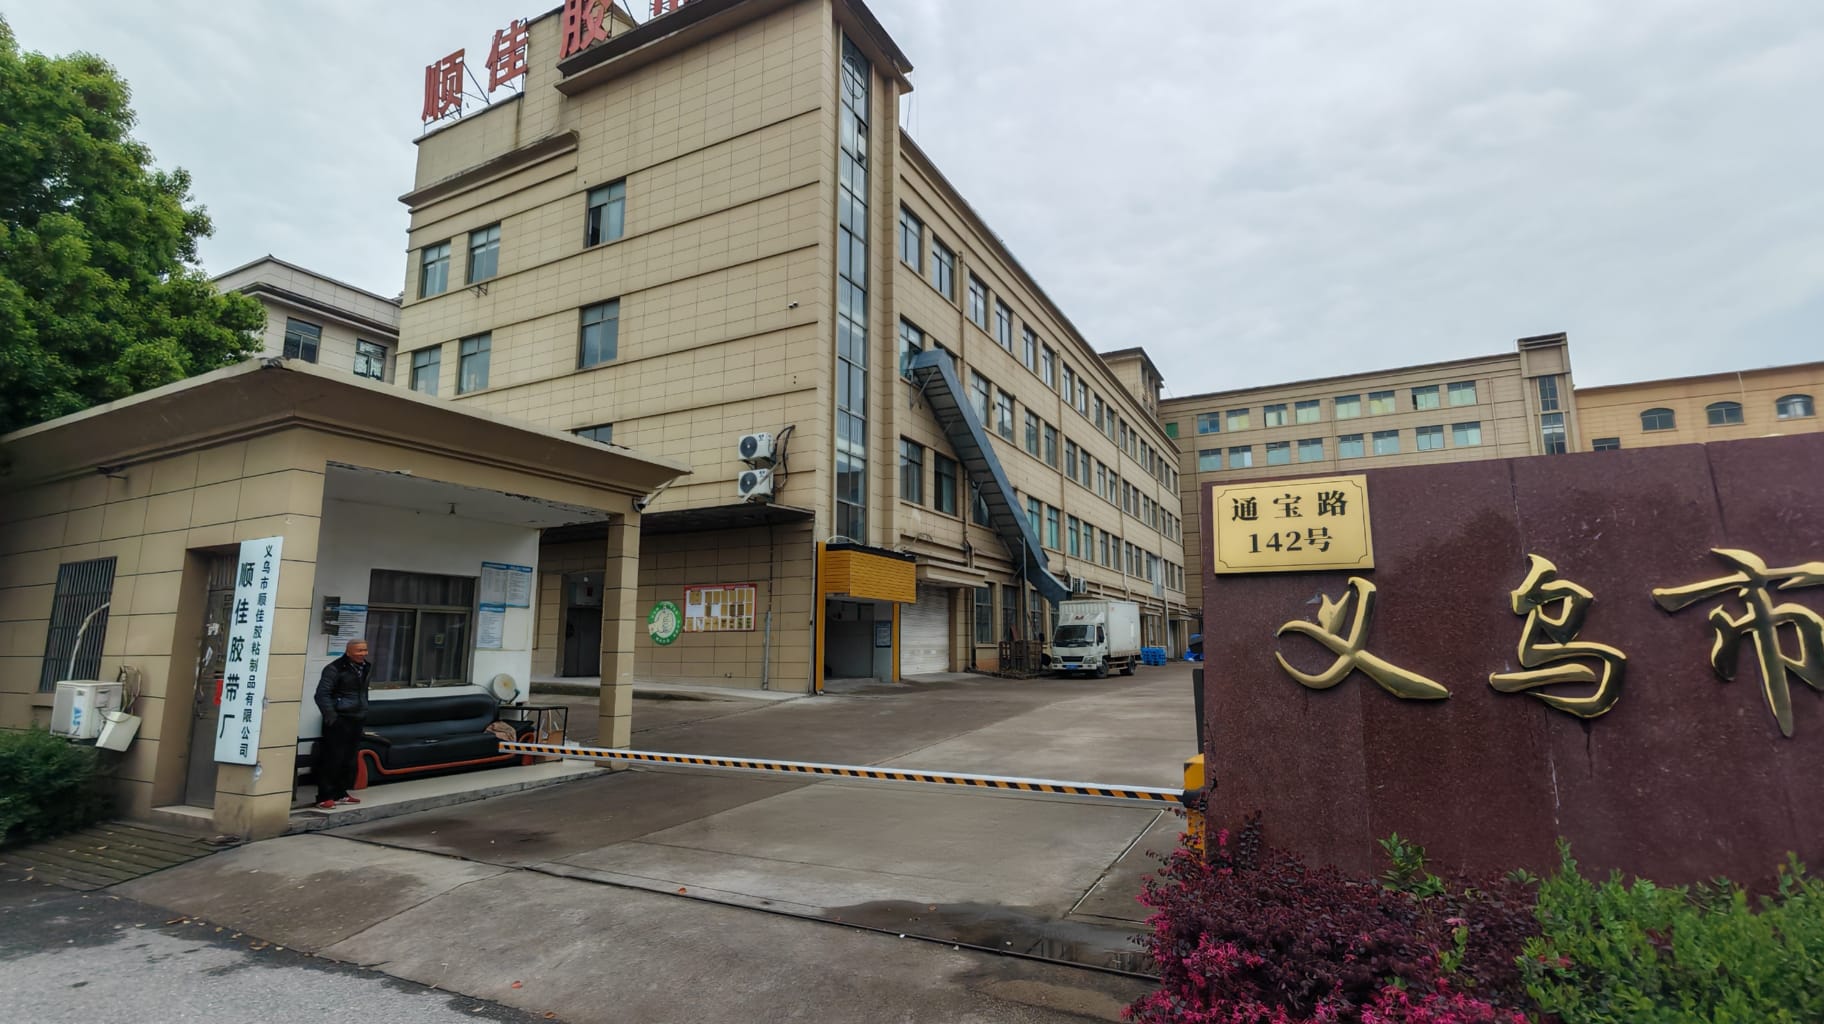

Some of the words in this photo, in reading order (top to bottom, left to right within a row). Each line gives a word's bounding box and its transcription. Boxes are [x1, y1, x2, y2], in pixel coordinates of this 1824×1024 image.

[1231, 489, 1348, 522] 通宝路
[1248, 527, 1333, 554] 142号
[219, 562, 255, 739] 顺佳胶带厂
[240, 545, 273, 758] 义乌市顺佳胶粘制品有限公司
[1274, 548, 1824, 738] 义乌市
